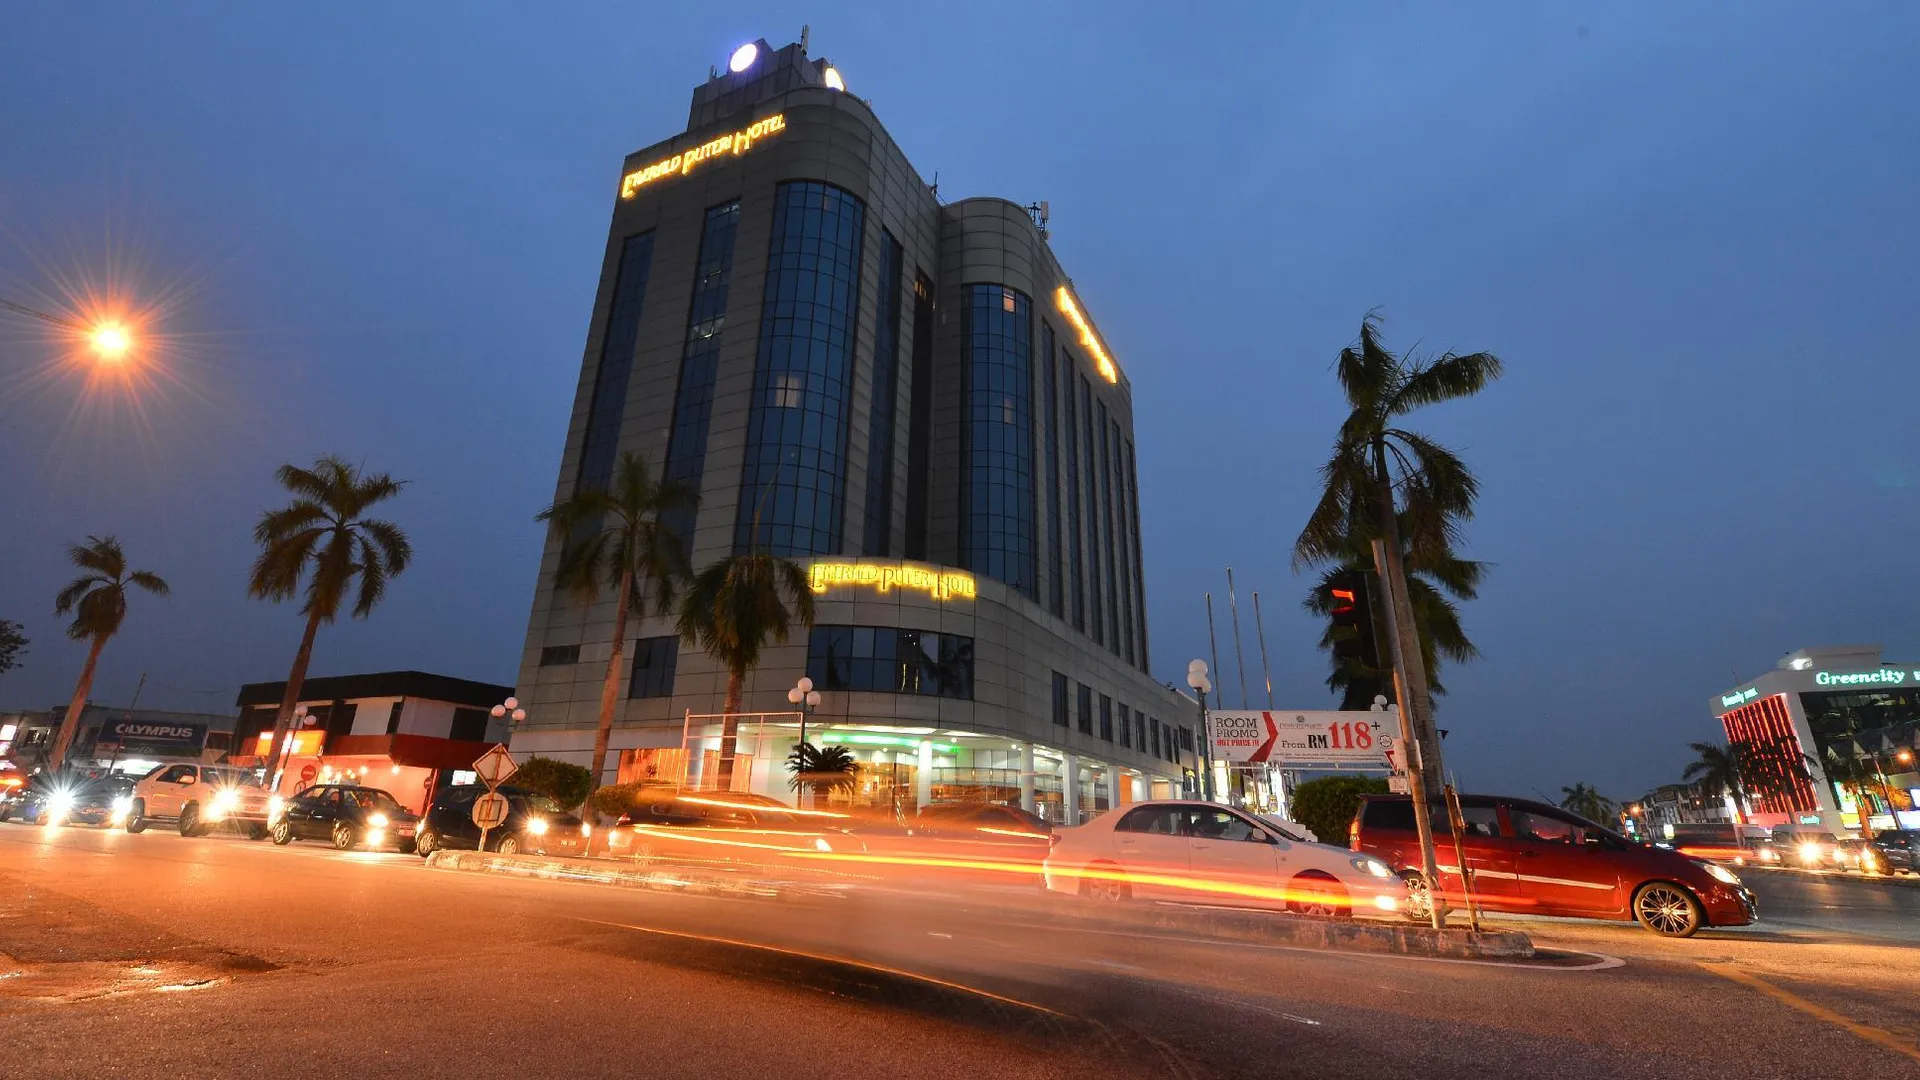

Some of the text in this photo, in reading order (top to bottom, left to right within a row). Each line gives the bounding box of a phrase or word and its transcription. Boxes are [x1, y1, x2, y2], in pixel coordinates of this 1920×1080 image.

[733, 113, 786, 155] HOTEL
[1816, 669, 1905, 685] Greencity
[1215, 717, 1257, 728] ROOM
[115, 723, 193, 738] OLYMPUS
[1216, 729, 1259, 738] PROMO
[1231, 739, 1251, 747] PRICE
[1282, 740, 1306, 749] From
[1307, 734, 1328, 749] RM
